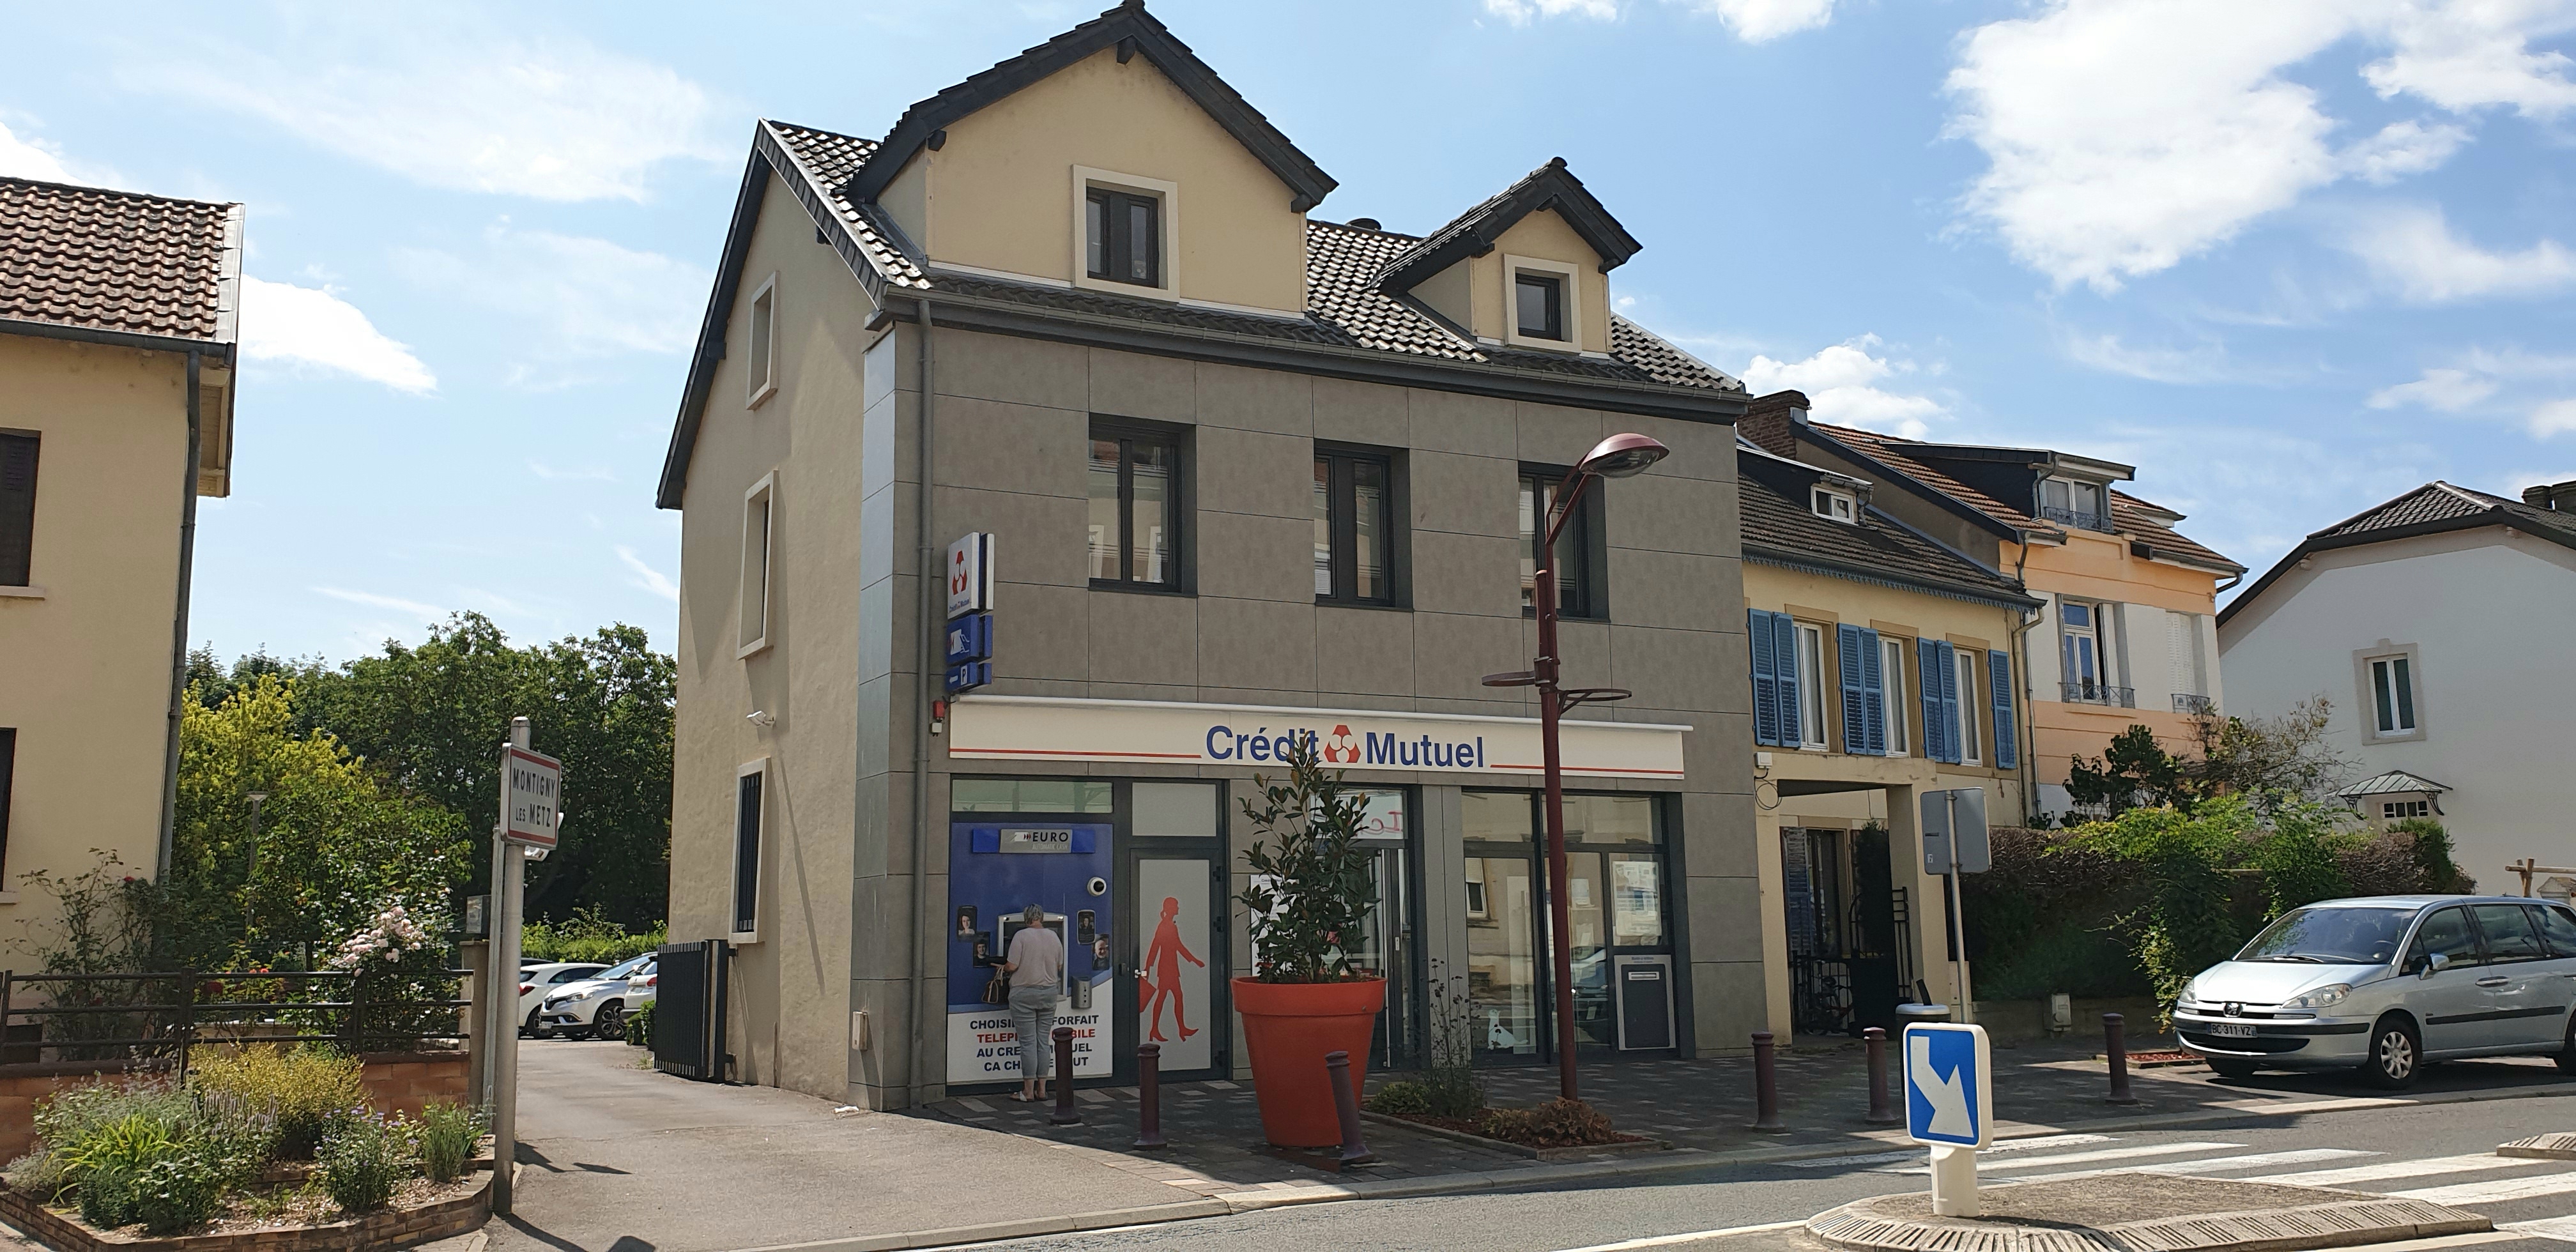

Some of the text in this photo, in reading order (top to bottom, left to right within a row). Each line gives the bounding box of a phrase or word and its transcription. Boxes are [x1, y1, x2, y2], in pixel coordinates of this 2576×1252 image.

[962, 668, 966, 683] P
[1366, 732, 1483, 768] Mutuel
[513, 767, 556, 798] MONTIGNY
[516, 803, 551, 827] LES METZ
[1032, 832, 1069, 843] EURO
[1052, 1014, 1099, 1026] FORFAIT
[2212, 1024, 2251, 1035] BC-311-VZ
[976, 1032, 1018, 1043] TELEP
[976, 1048, 993, 1058] AU
[997, 1046, 1021, 1057] CRE
[984, 1062, 1001, 1071] CA
